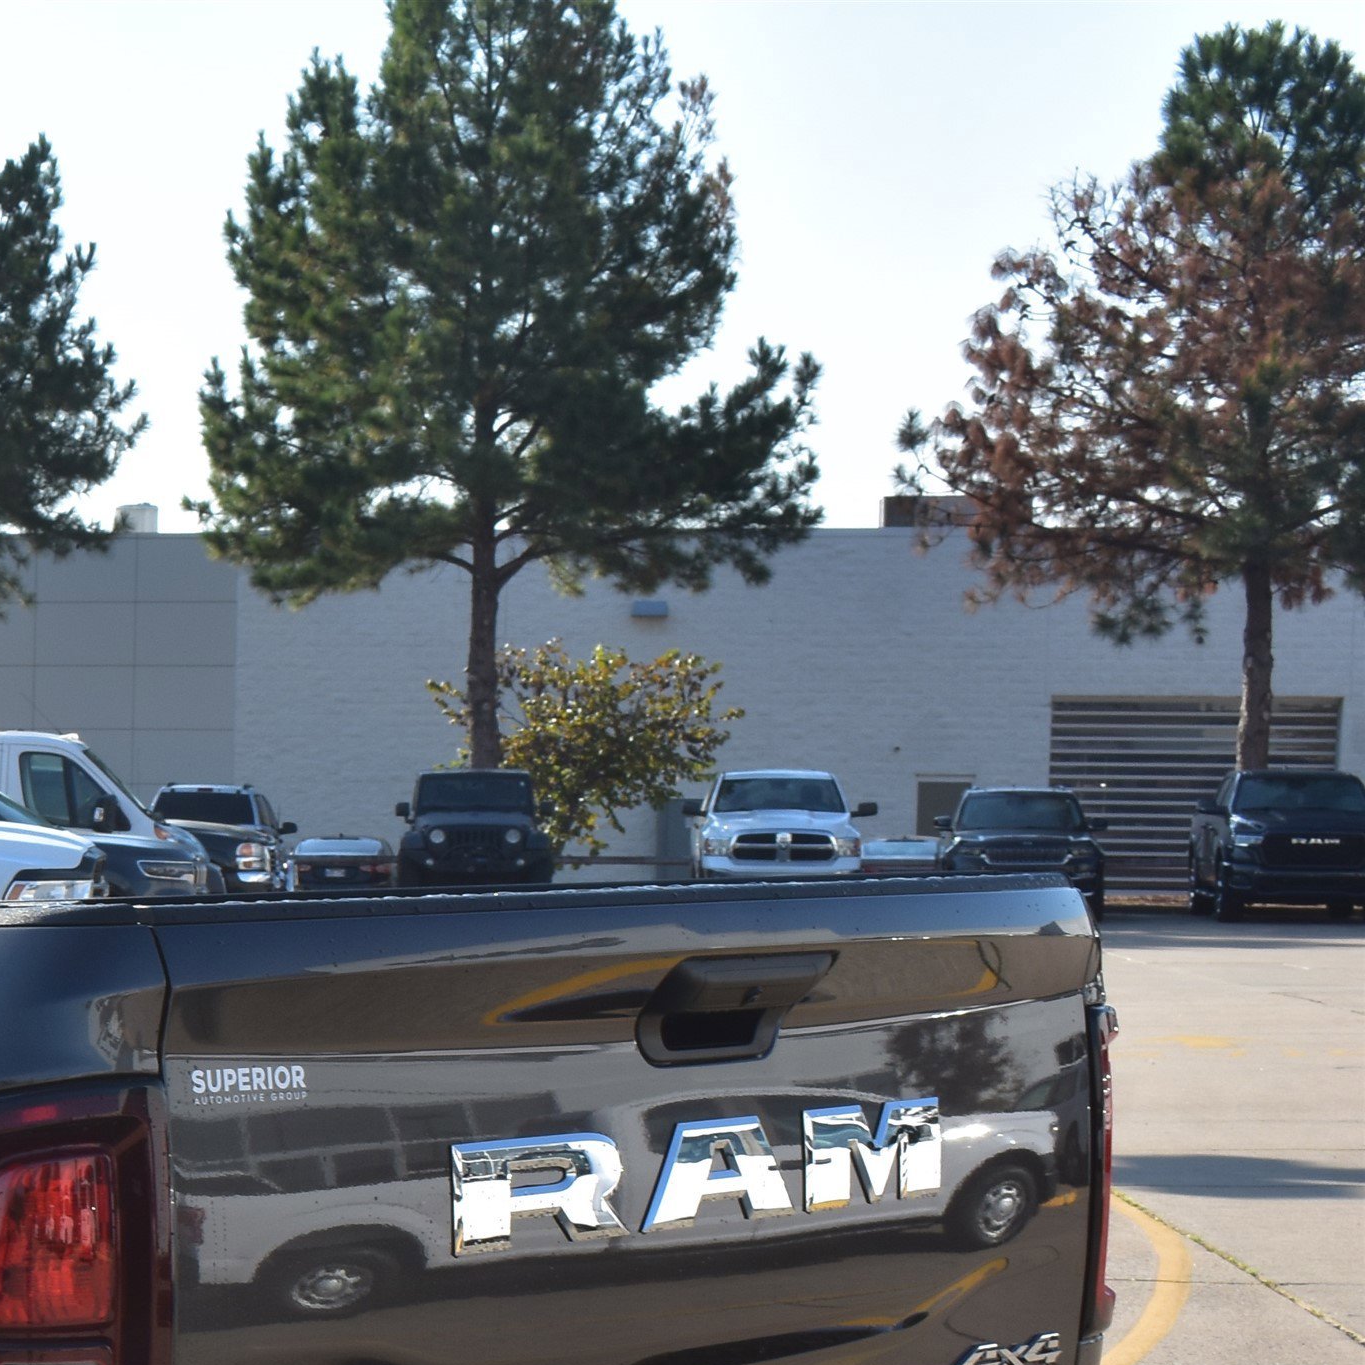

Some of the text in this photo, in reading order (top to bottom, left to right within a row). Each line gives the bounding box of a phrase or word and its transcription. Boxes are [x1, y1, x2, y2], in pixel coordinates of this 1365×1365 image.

[191, 1065, 307, 1094] SUPERIOR
[194, 1091, 307, 1105] AUTOMOTIVE GROUP
[451, 1096, 942, 1257] RAM
